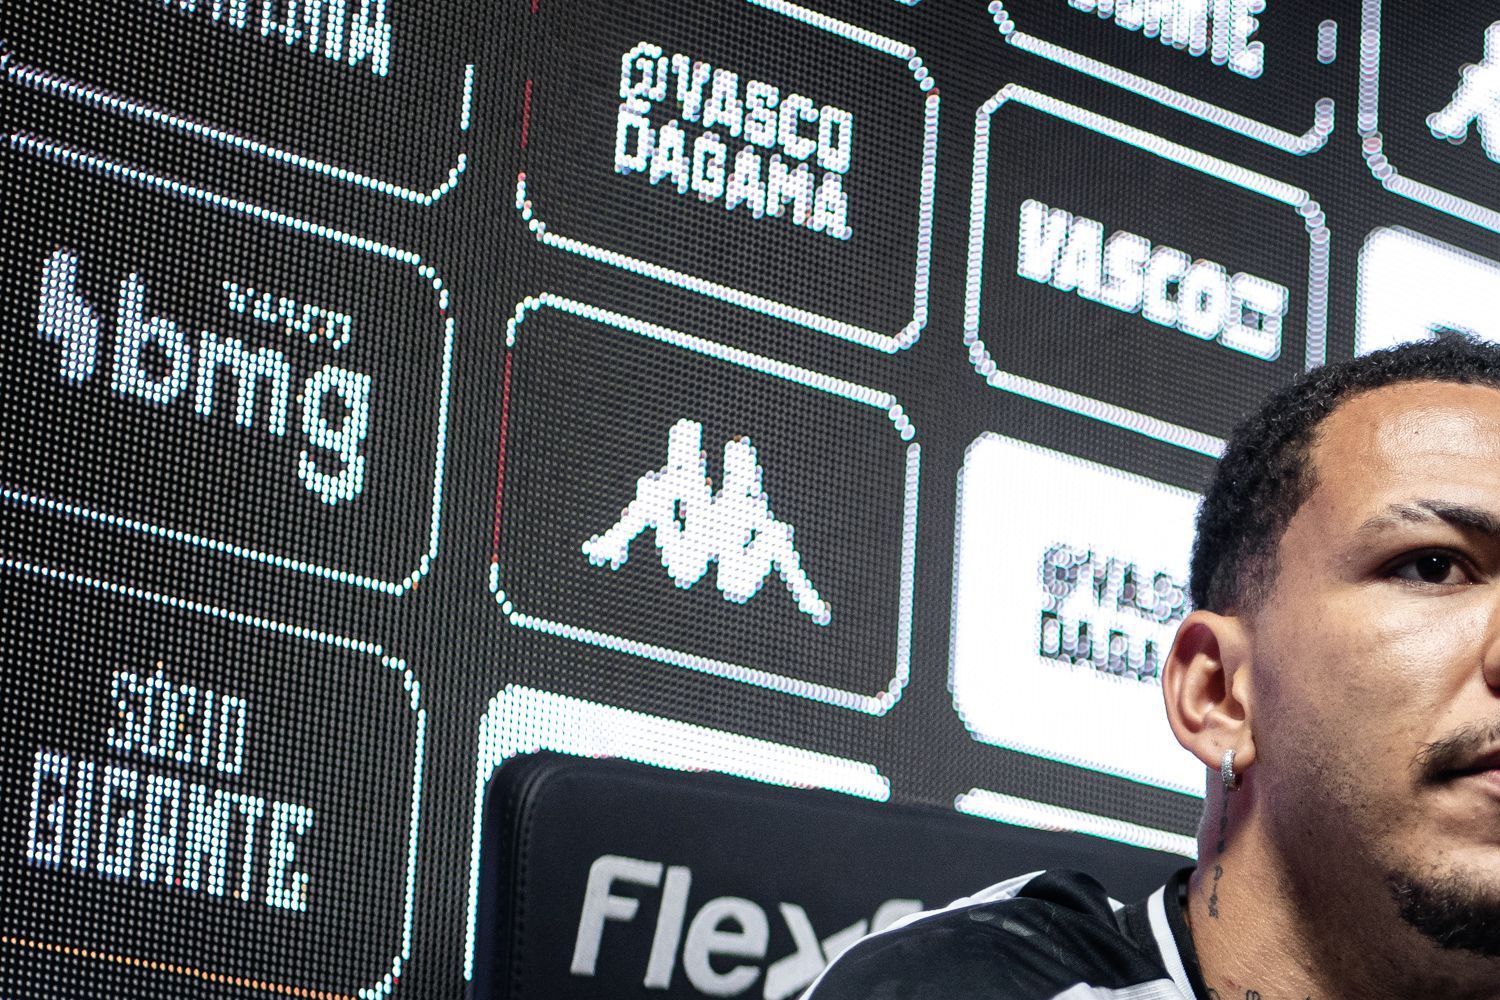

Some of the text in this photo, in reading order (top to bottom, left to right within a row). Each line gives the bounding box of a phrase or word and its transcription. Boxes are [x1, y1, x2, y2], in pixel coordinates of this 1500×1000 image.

[614, 108, 853, 241] DAGAMA
[619, 41, 854, 175] @VASCO
[111, 272, 372, 503] bmg
[26, 750, 315, 912] GIGANTE
